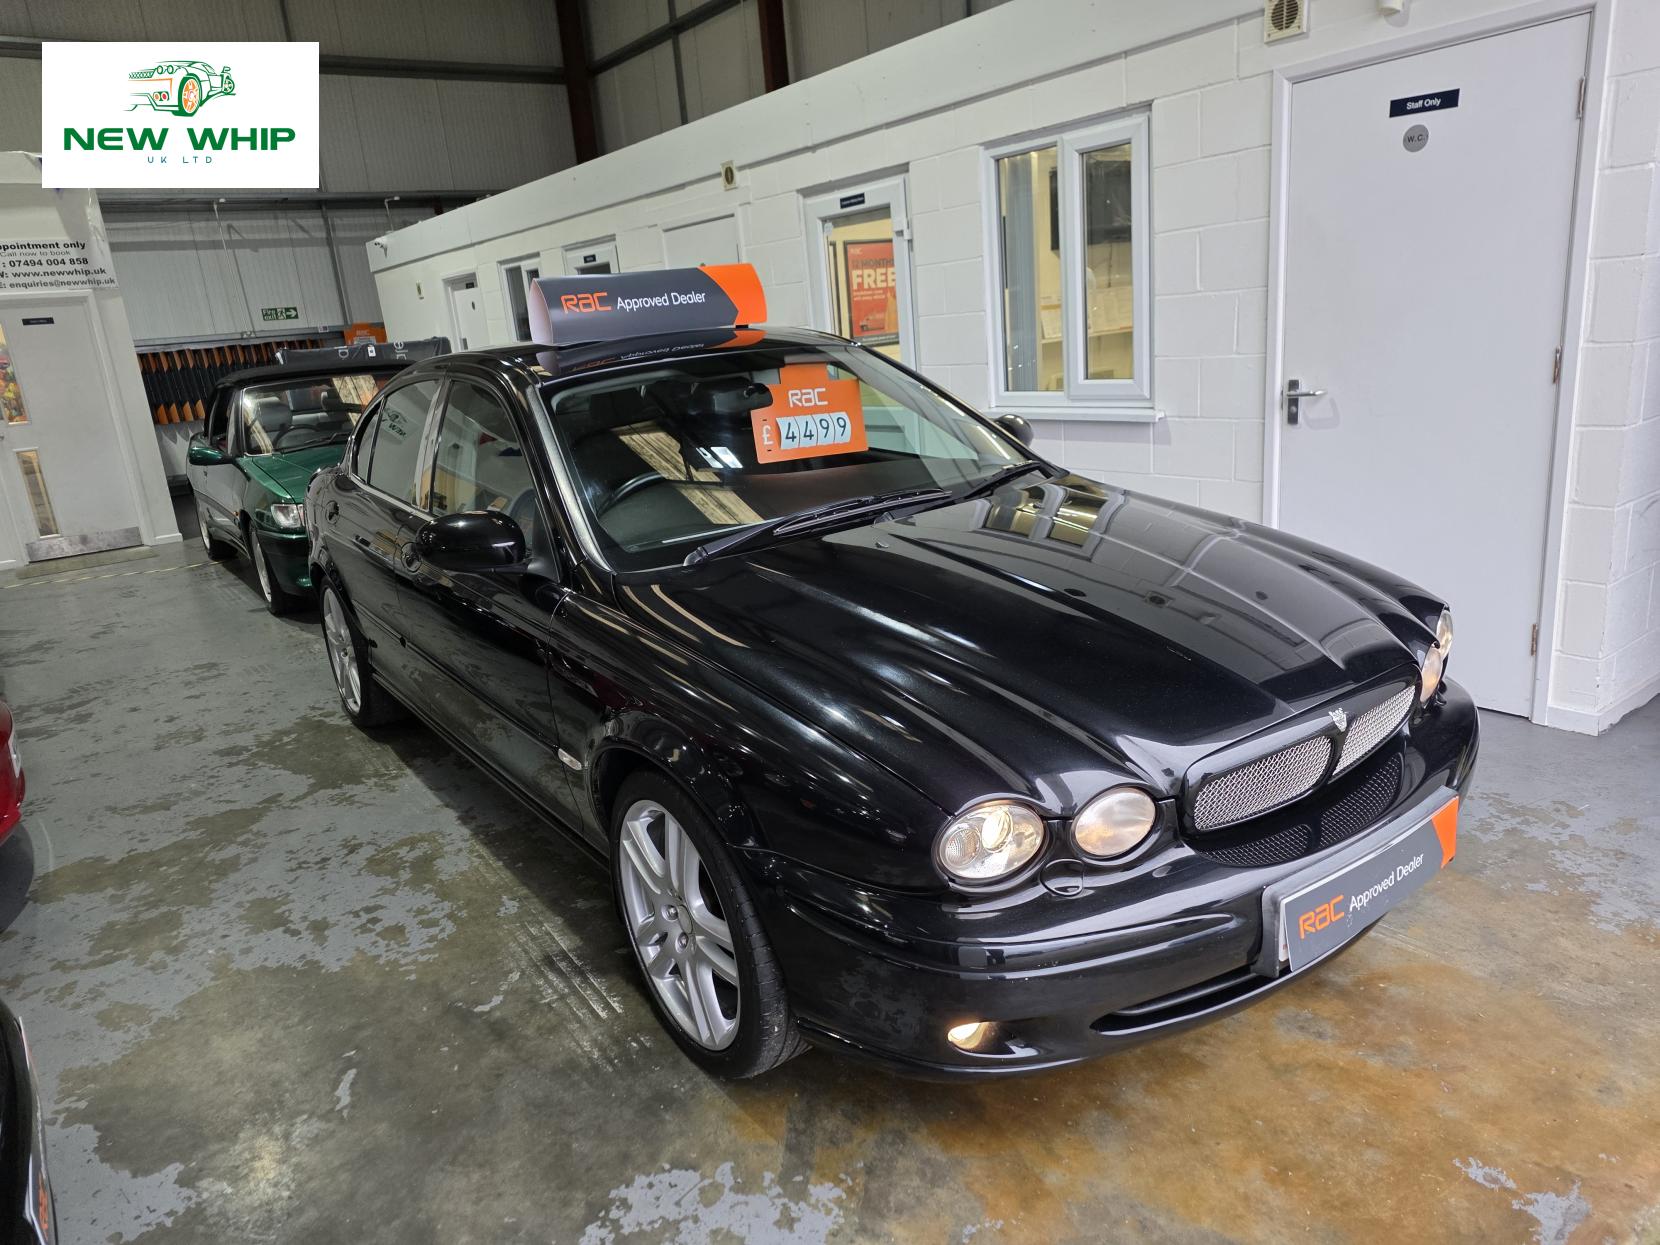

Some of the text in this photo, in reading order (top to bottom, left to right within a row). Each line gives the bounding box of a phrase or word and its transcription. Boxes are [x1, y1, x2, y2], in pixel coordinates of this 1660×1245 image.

[1406, 97, 1442, 110] Staff Only
[0, 241, 86, 252] pointment only
[9, 259, 43, 267] 07494
[46, 258, 66, 266] 004
[69, 257, 89, 266] 858
[11, 267, 107, 277] www.newwhip.uk
[851, 267, 896, 290] FREE
[9, 277, 115, 289] enquiries@newwhip.uk
[616, 293, 670, 312] Approved
[672, 291, 706, 305] Dealer
[785, 416, 847, 442] 4499
[1349, 871, 1395, 912] Approved
[1396, 853, 1425, 882] Dealer
